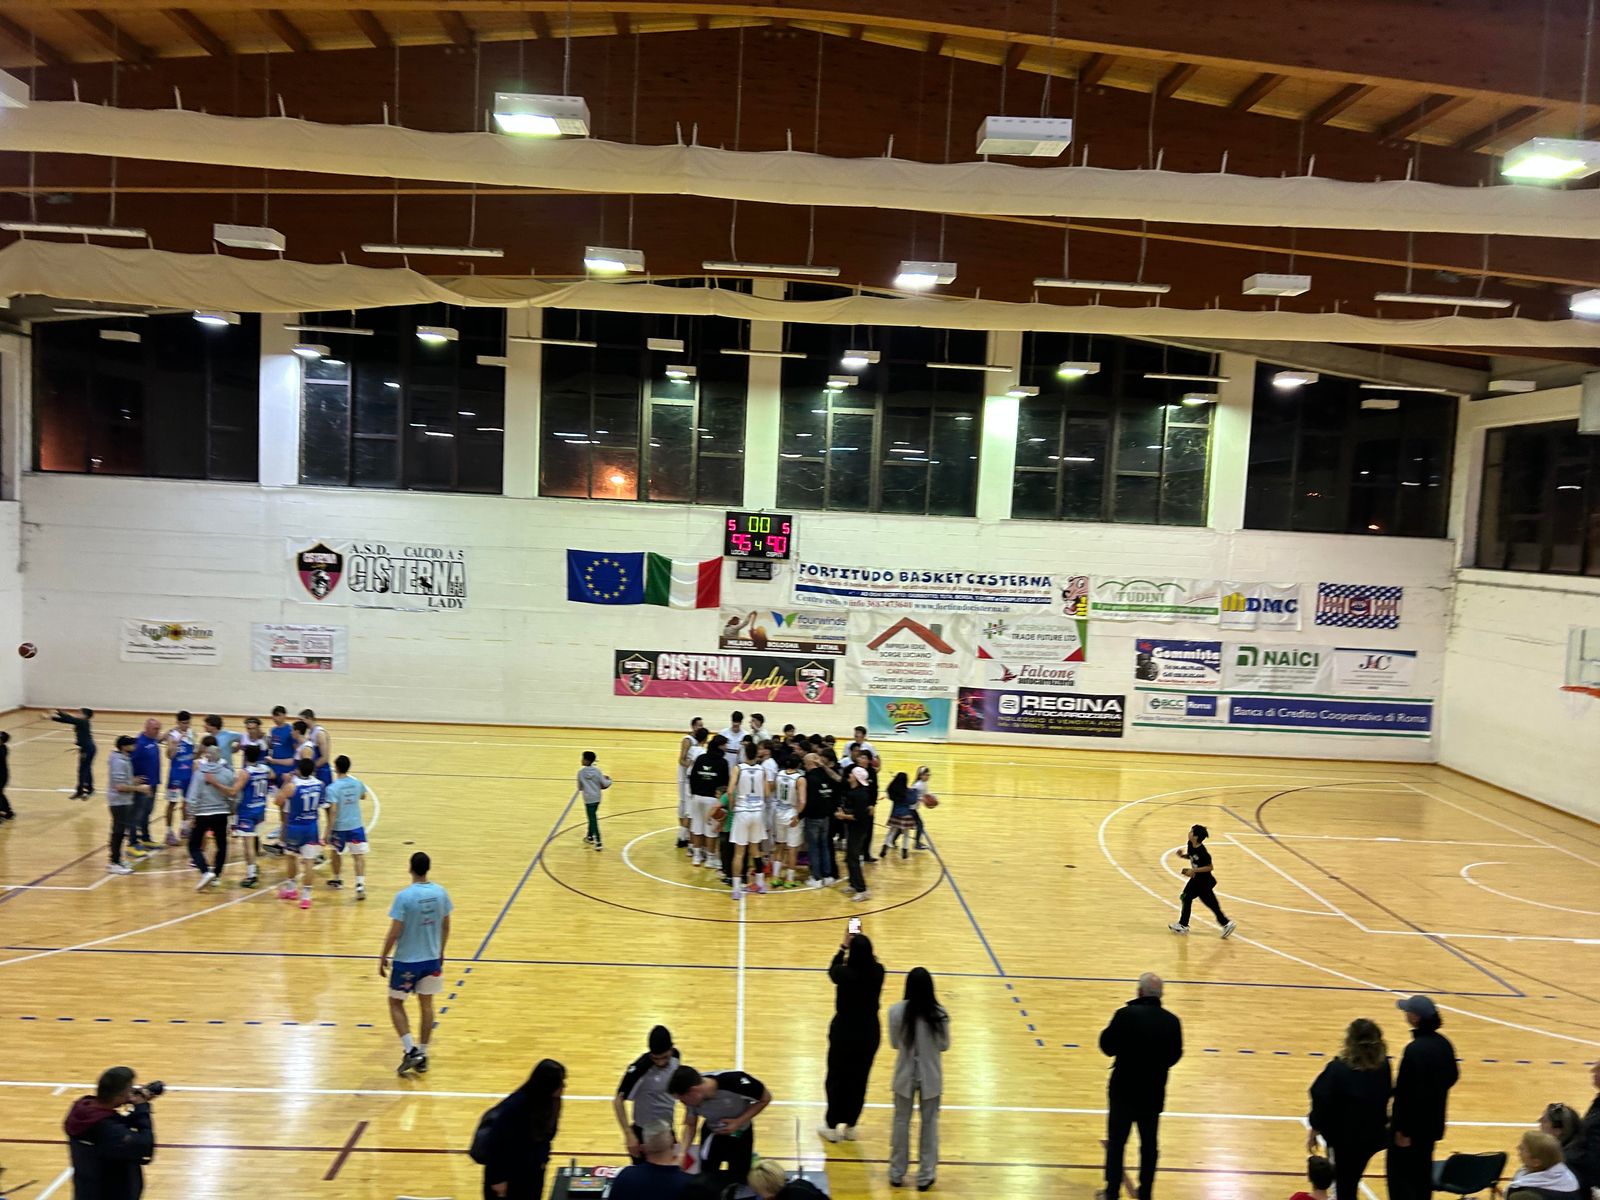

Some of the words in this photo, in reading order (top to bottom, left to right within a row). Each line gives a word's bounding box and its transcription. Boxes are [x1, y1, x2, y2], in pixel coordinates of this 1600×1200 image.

[782, 522, 790, 534] 5
[349, 543, 391, 555] A.S.D.
[403, 546, 443, 557] CALCIO
[448, 549, 454, 557] A
[458, 549, 465, 559] 5
[755, 540, 762, 550] 4
[346, 554, 466, 597] CISTERNA
[799, 563, 894, 582] FORTITUDO
[899, 570, 964, 584] BASKET
[967, 573, 1052, 587] CISTERNA
[428, 597, 466, 609] LADY
[1246, 597, 1298, 614] DMC
[797, 614, 847, 626] fourwinds
[656, 653, 743, 683] CISTERNA
[1019, 664, 1075, 679] Falcone
[731, 666, 789, 701] Lady
[1021, 695, 1122, 713] REGINA
[1233, 706, 1263, 717] Banca
[1265, 707, 1276, 717] di
[1277, 707, 1317, 719] Credito
[1319, 709, 1382, 723] Cooperativo
[1384, 711, 1395, 722] di
[1396, 712, 1427, 723] Roma
[300, 792, 320, 812] 17
